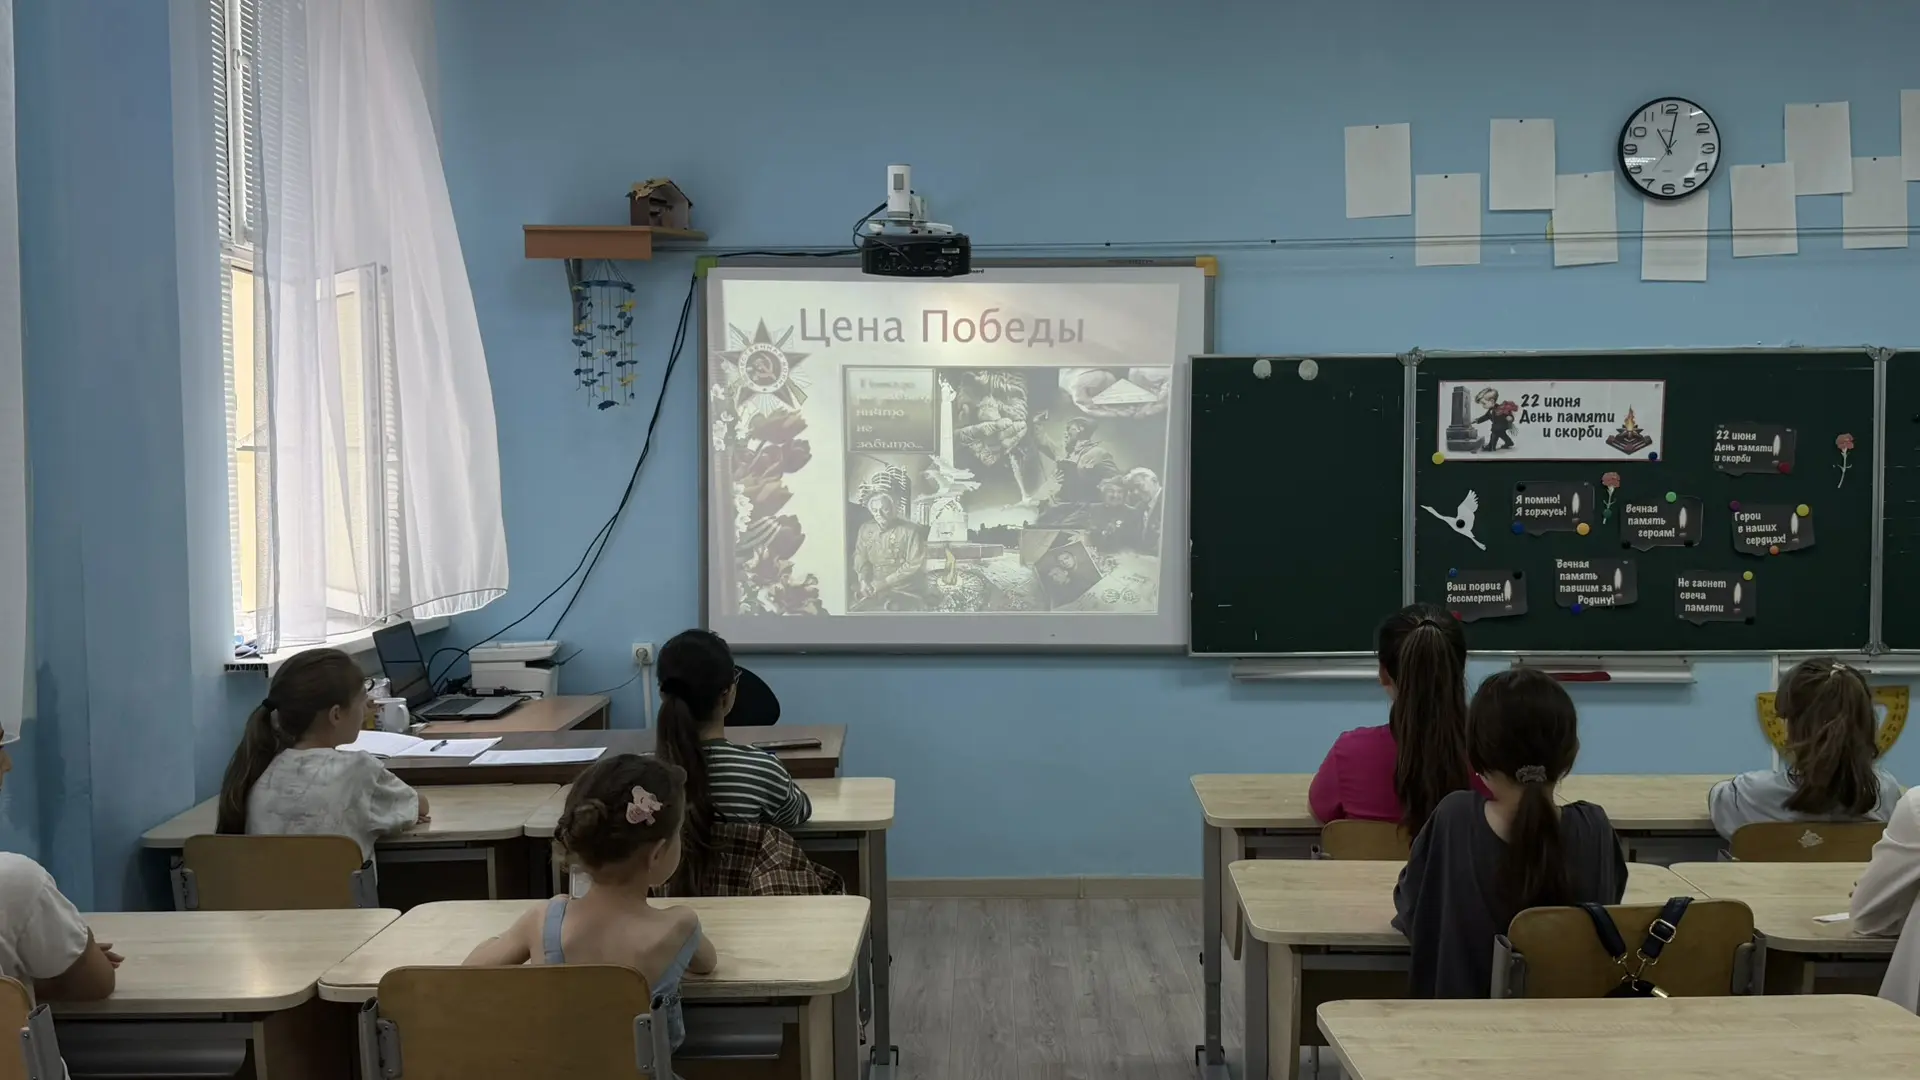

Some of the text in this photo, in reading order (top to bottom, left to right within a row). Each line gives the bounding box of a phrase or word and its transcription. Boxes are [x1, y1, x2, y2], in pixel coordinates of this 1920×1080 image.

[1660, 103, 1679, 115] 12
[1643, 111, 1654, 122] 11
[1629, 126, 1647, 138] 10
[1696, 122, 1710, 134] 2
[1623, 143, 1638, 155] 9
[1701, 142, 1716, 154] 3
[1695, 162, 1709, 174] 4
[1641, 178, 1655, 189] 7
[1682, 177, 1696, 188] 5
[1661, 183, 1676, 195] 6
[799, 307, 1085, 348] Цена Победы
[1520, 393, 1581, 408] 22 июня
[1519, 409, 1615, 424] День памяти
[1542, 424, 1603, 440] и скорби
[1716, 429, 1757, 441] 22 июня
[1714, 441, 1773, 452] День памяти
[1714, 453, 1752, 464] и скорби
[1515, 493, 1560, 505] Я помню!
[1515, 505, 1567, 518] Я горжусь!
[1625, 503, 1658, 514] Вечная
[1627, 517, 1666, 526] память
[1734, 511, 1761, 523] Герои
[1638, 527, 1675, 540] героям!
[1737, 523, 1777, 534] в наших
[1745, 533, 1786, 547] сердцах!
[1556, 559, 1590, 569] Вечная
[1559, 572, 1598, 581] память
[1446, 581, 1501, 593] Ваш подвиг
[1559, 584, 1613, 593] павшим за
[1677, 577, 1727, 589] Не гаснет
[1446, 592, 1504, 604] бессмертен!
[1577, 594, 1615, 606] Родину!
[1679, 591, 1706, 600] свеча
[1684, 603, 1724, 613] памяти
